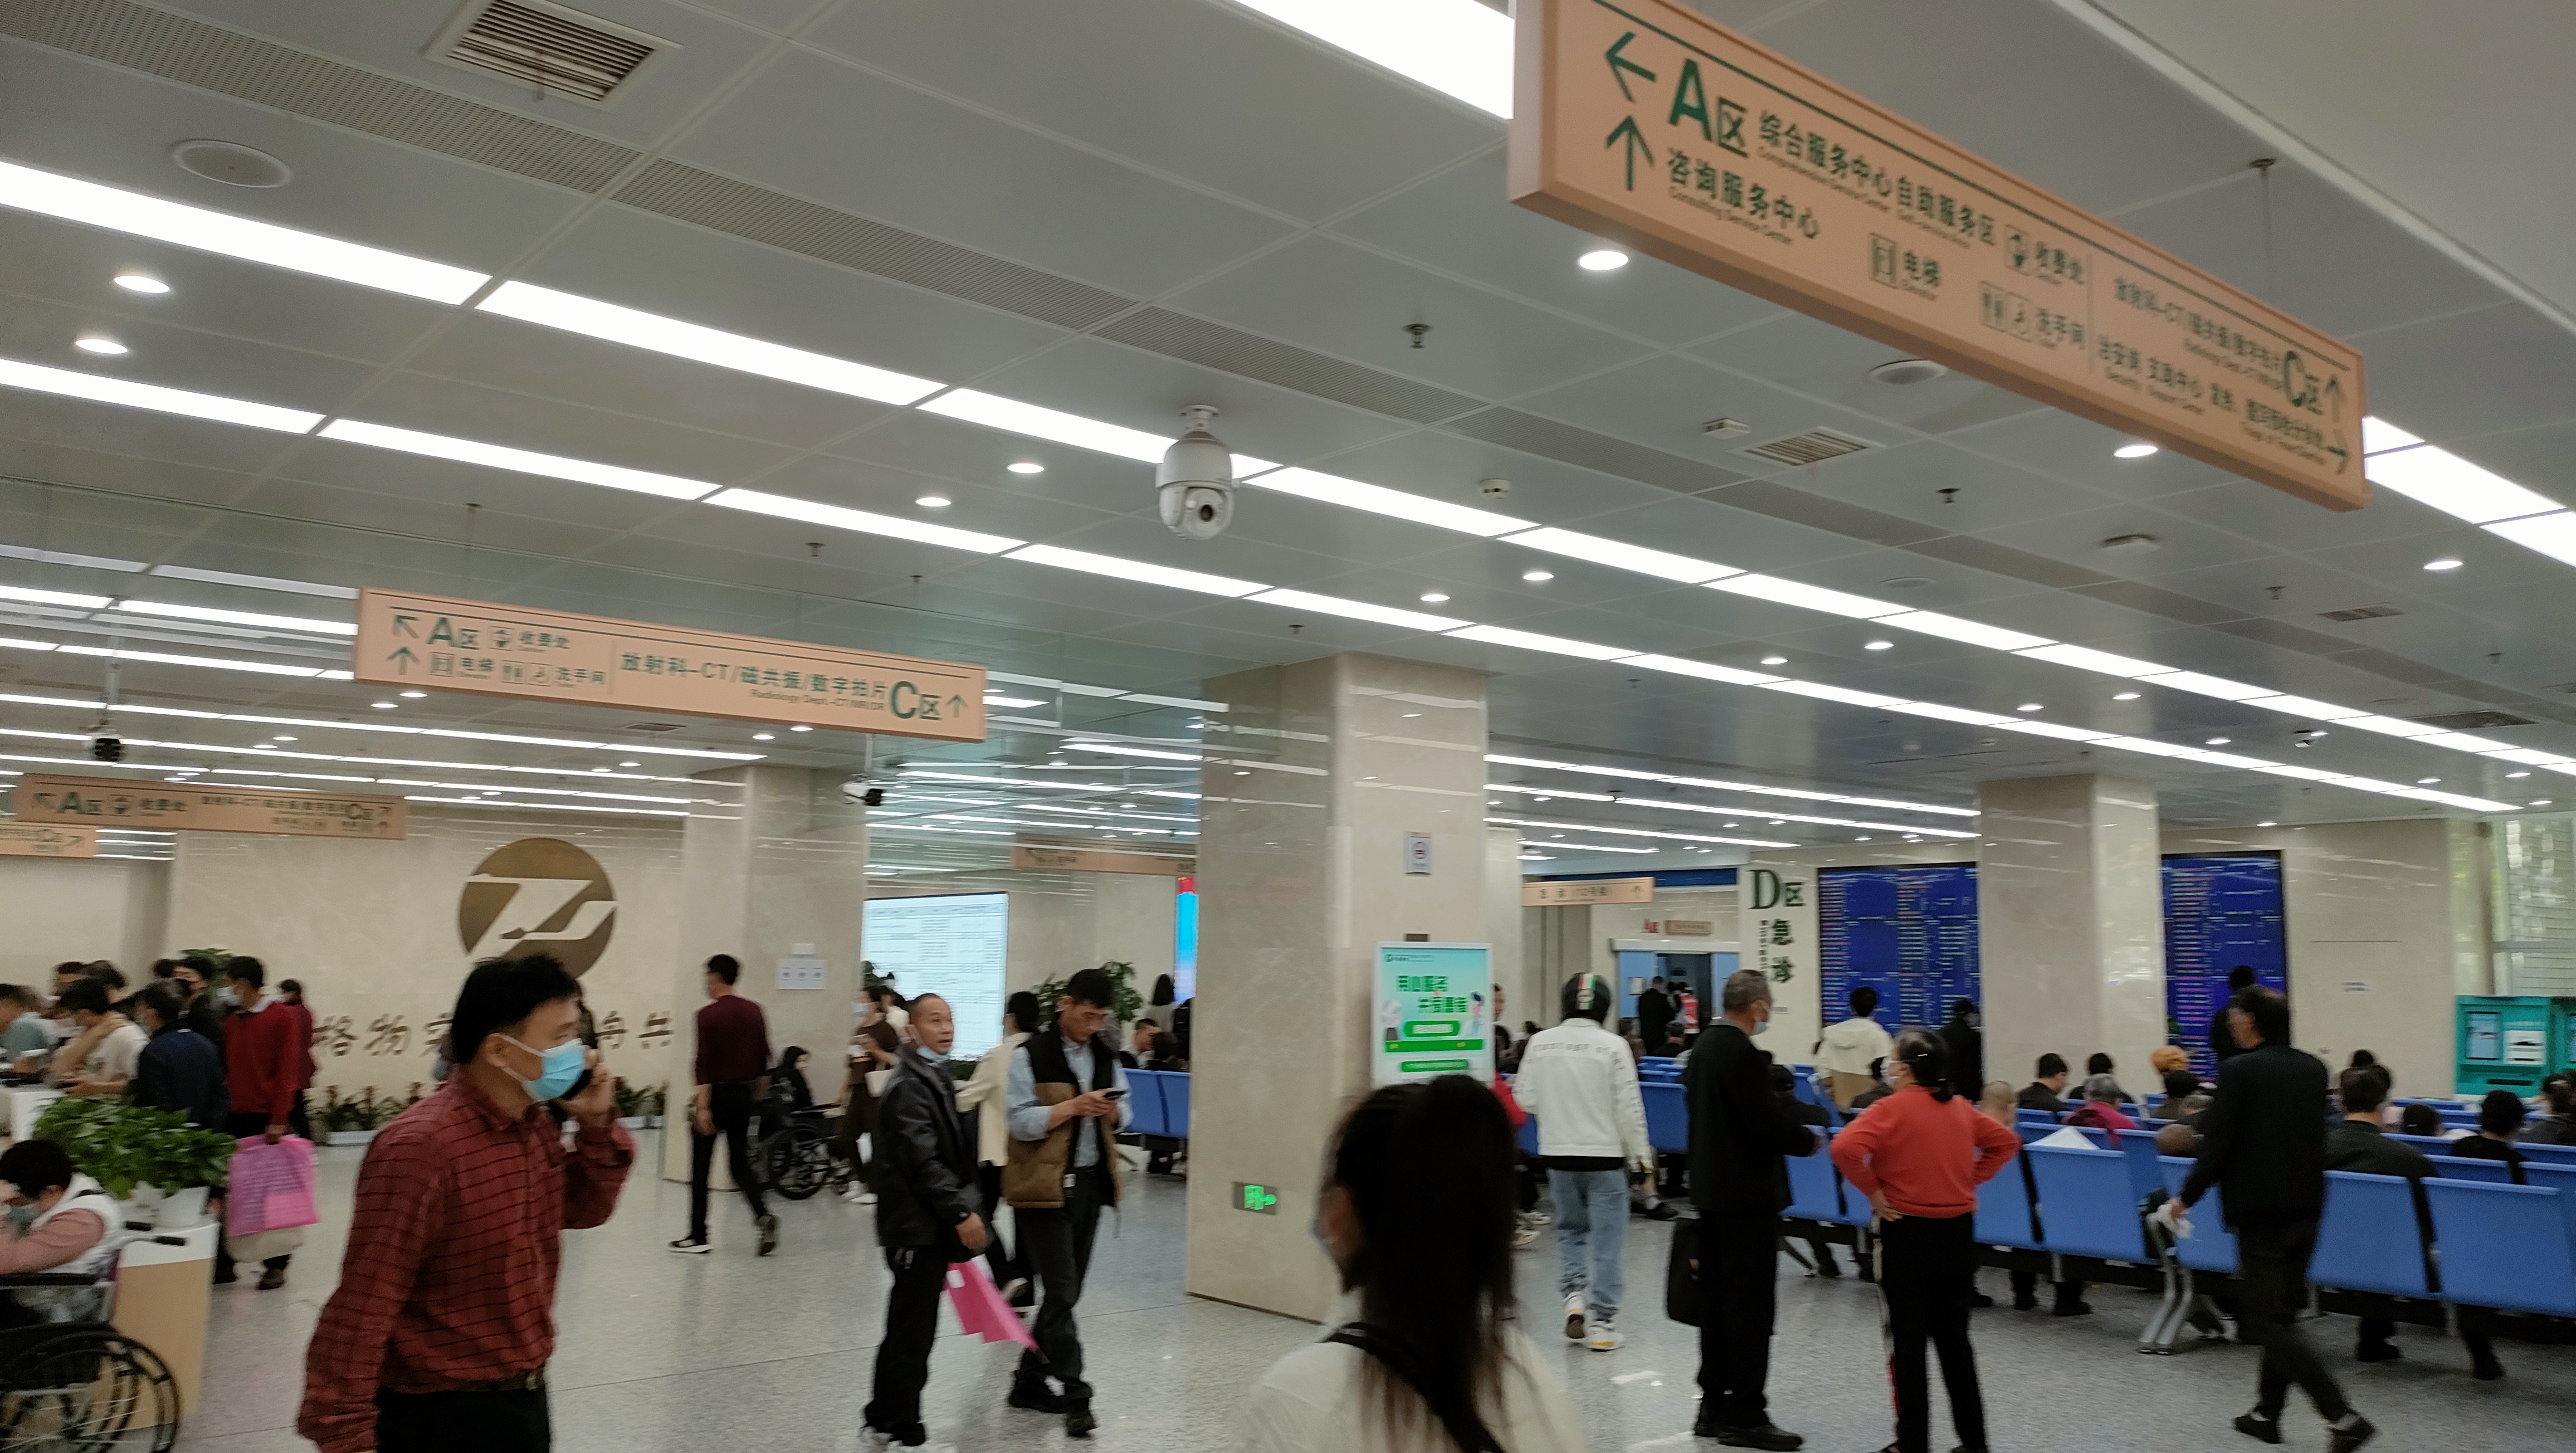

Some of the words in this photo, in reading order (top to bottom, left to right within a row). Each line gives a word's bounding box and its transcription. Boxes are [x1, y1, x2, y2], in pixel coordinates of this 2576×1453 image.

[1668, 58, 1749, 158] A区
[1759, 111, 1892, 197] 综合服务中心
[1897, 176, 1996, 246] 自助服务区
[1668, 147, 1820, 238] 咨询服务中心
[1904, 249, 1941, 288] 电梯
[426, 617, 480, 650] A区
[519, 630, 570, 650] 收费处
[460, 657, 494, 672] 电梯
[557, 667, 606, 685] 洗手间
[890, 680, 941, 720] C区
[1745, 869, 1806, 910] D区
[1771, 919, 1794, 983] 急诊
